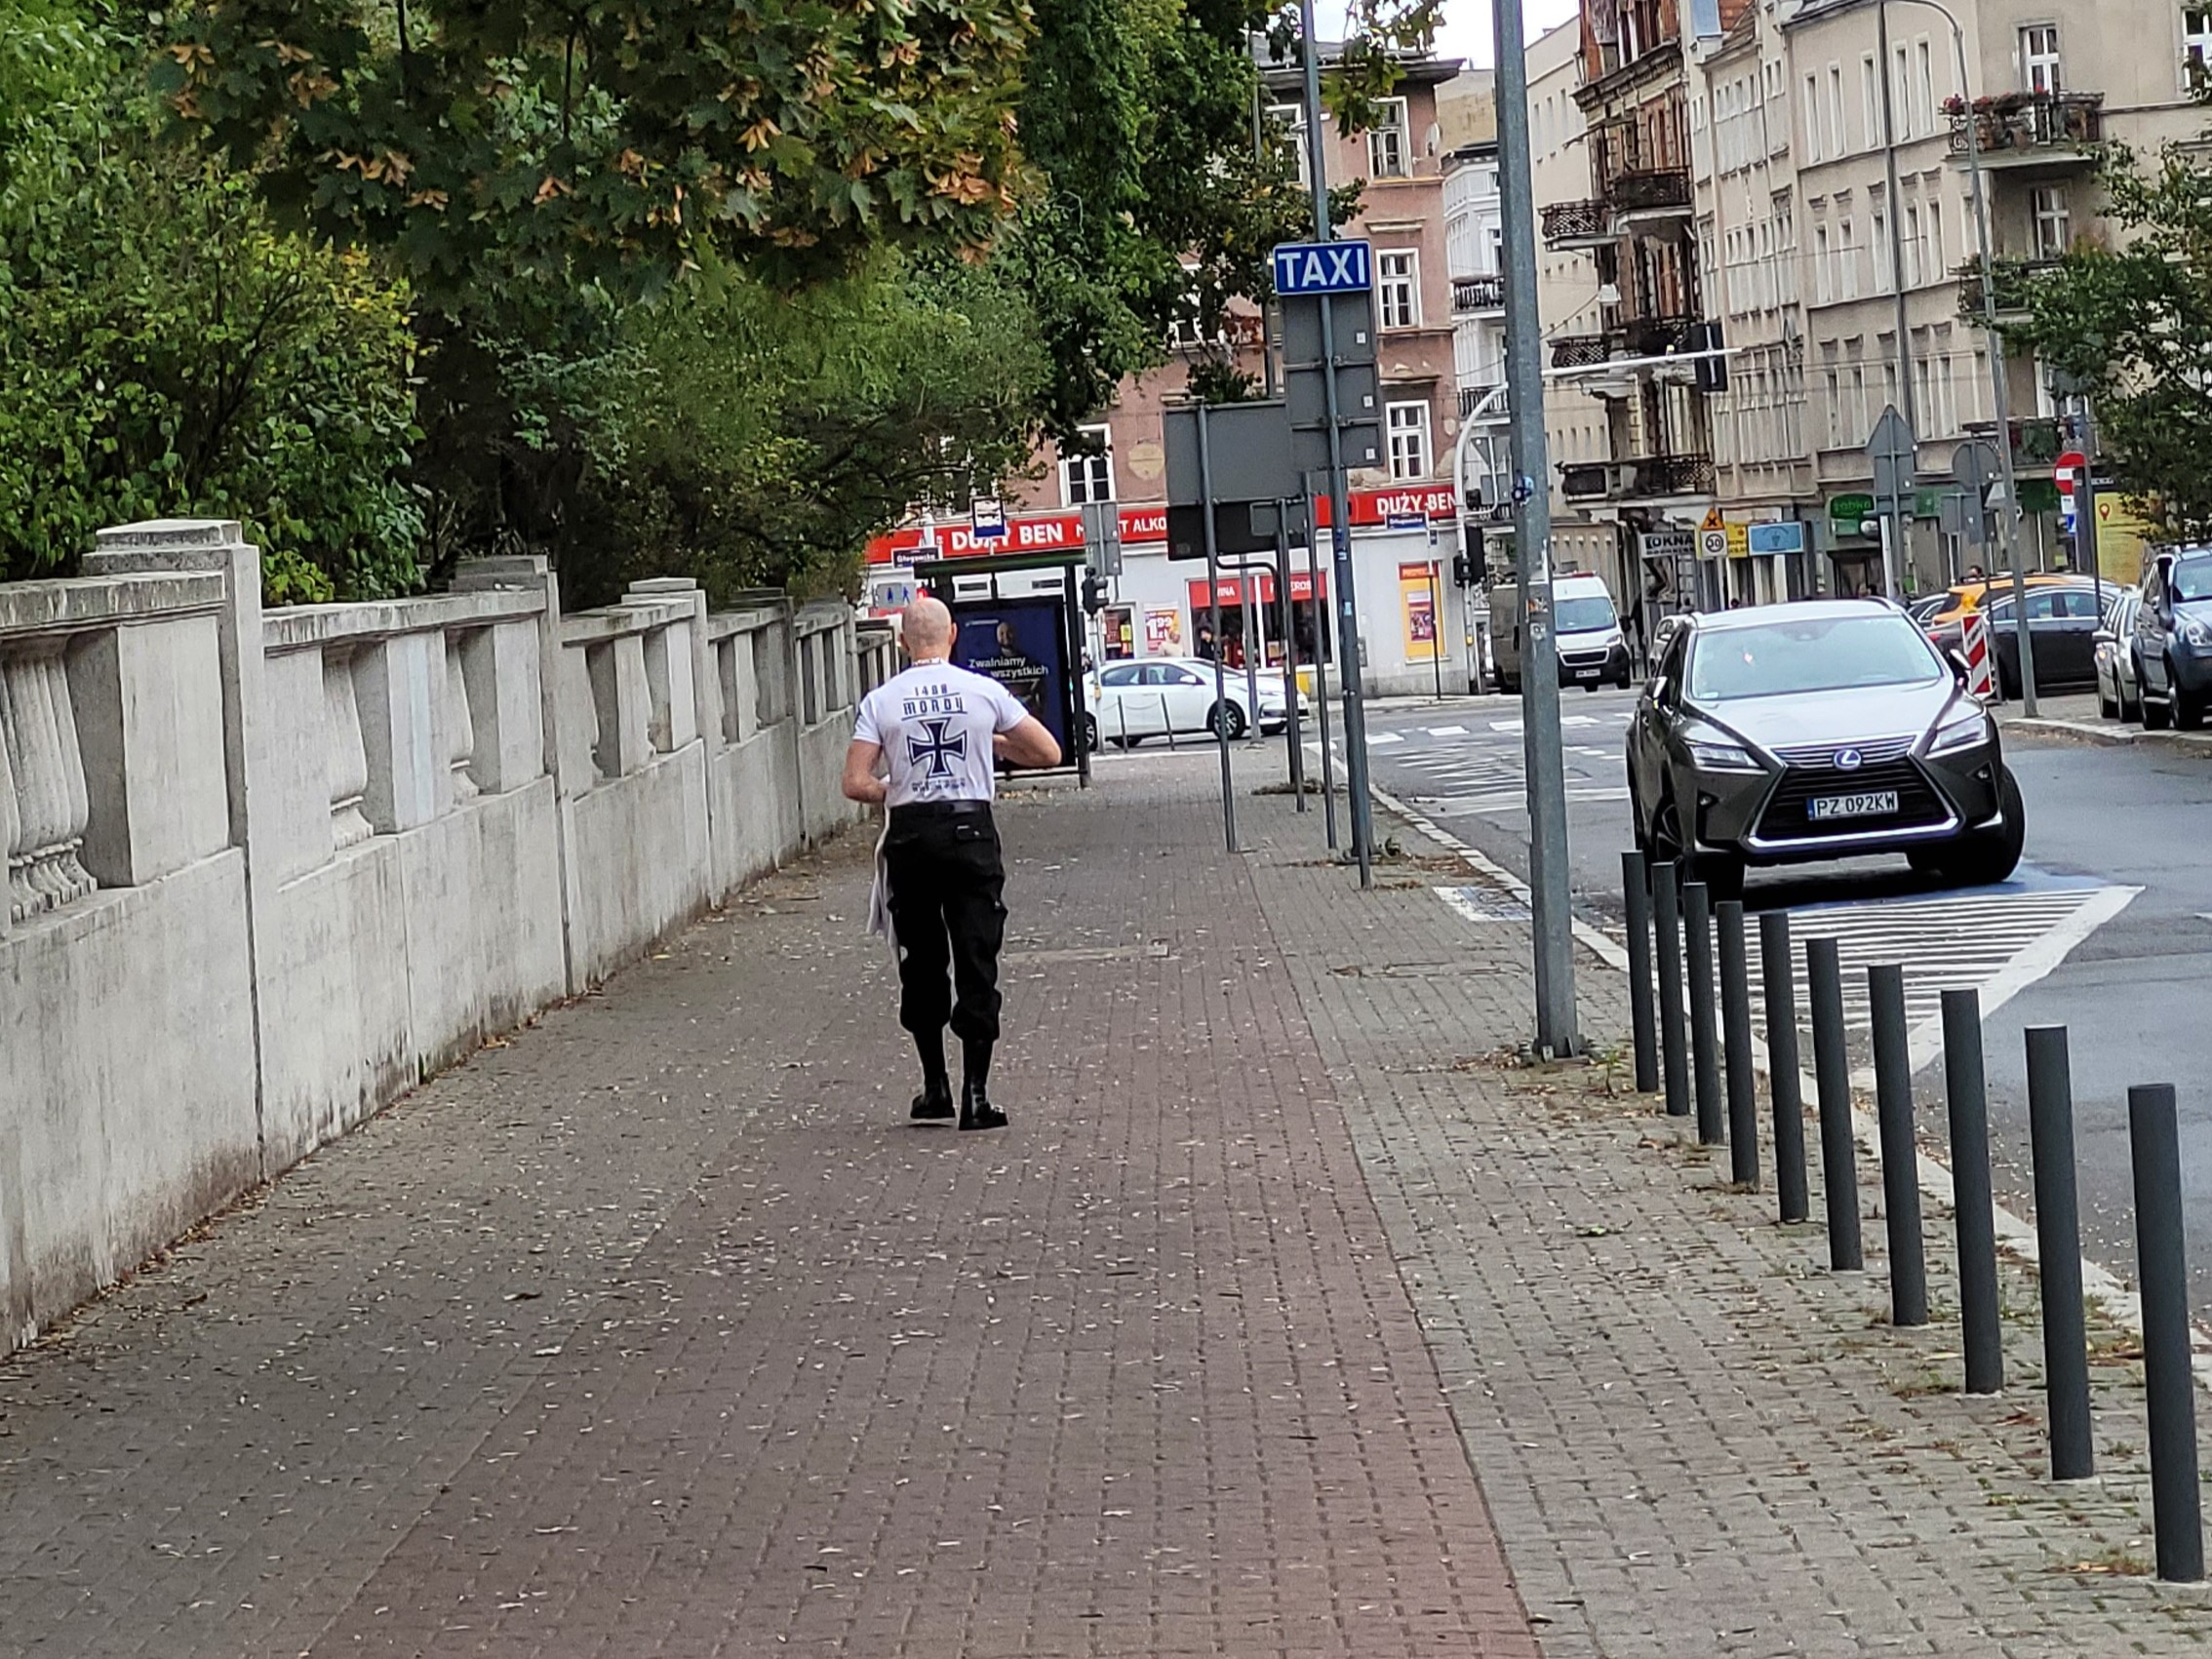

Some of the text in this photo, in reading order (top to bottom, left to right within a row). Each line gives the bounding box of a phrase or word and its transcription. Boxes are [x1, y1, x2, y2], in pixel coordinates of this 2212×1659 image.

[1277, 248, 1365, 289] TAXI
[1376, 491, 1456, 515] DUŻY BEN
[1018, 523, 1063, 545] BEN
[1652, 533, 1694, 547] OKNA
[968, 656, 1027, 669] Zwalniamy
[990, 665, 1049, 680] wszystkich
[1816, 792, 1895, 816] PZ 092KW
